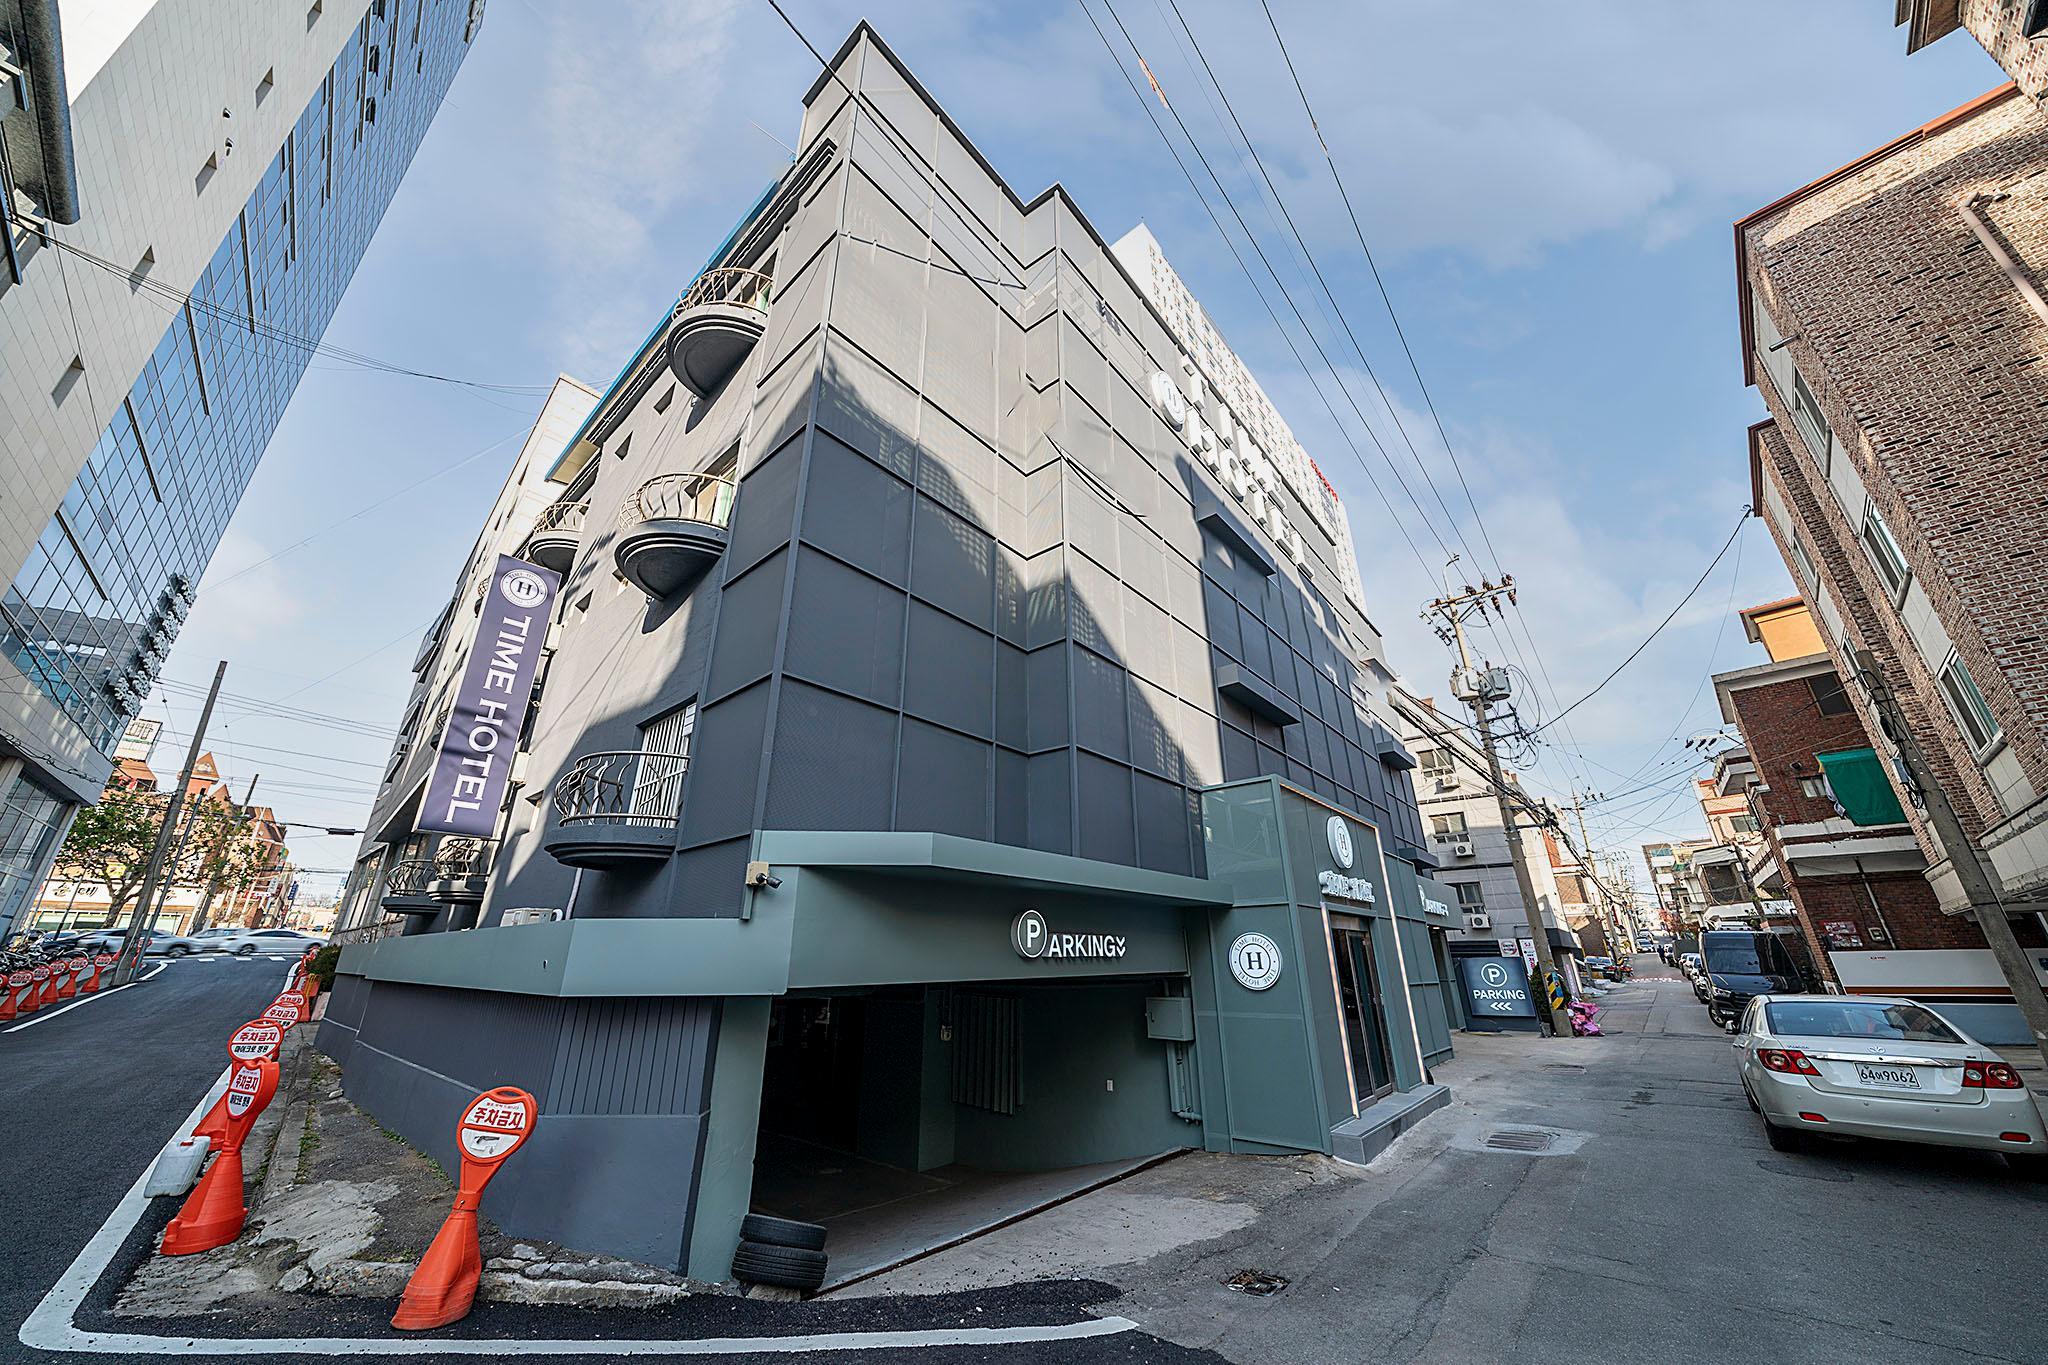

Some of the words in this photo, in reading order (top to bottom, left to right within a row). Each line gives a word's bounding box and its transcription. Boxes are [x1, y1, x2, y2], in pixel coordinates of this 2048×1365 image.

[482, 615, 533, 695] TIME
[444, 698, 508, 824] HOTEL
[1251, 936, 1274, 953] HOTEL
[1245, 951, 1264, 971] H
[1473, 989, 1526, 1000] PARKING
[239, 1031, 277, 1042] 주차금지
[473, 1106, 524, 1128] 주차금지
